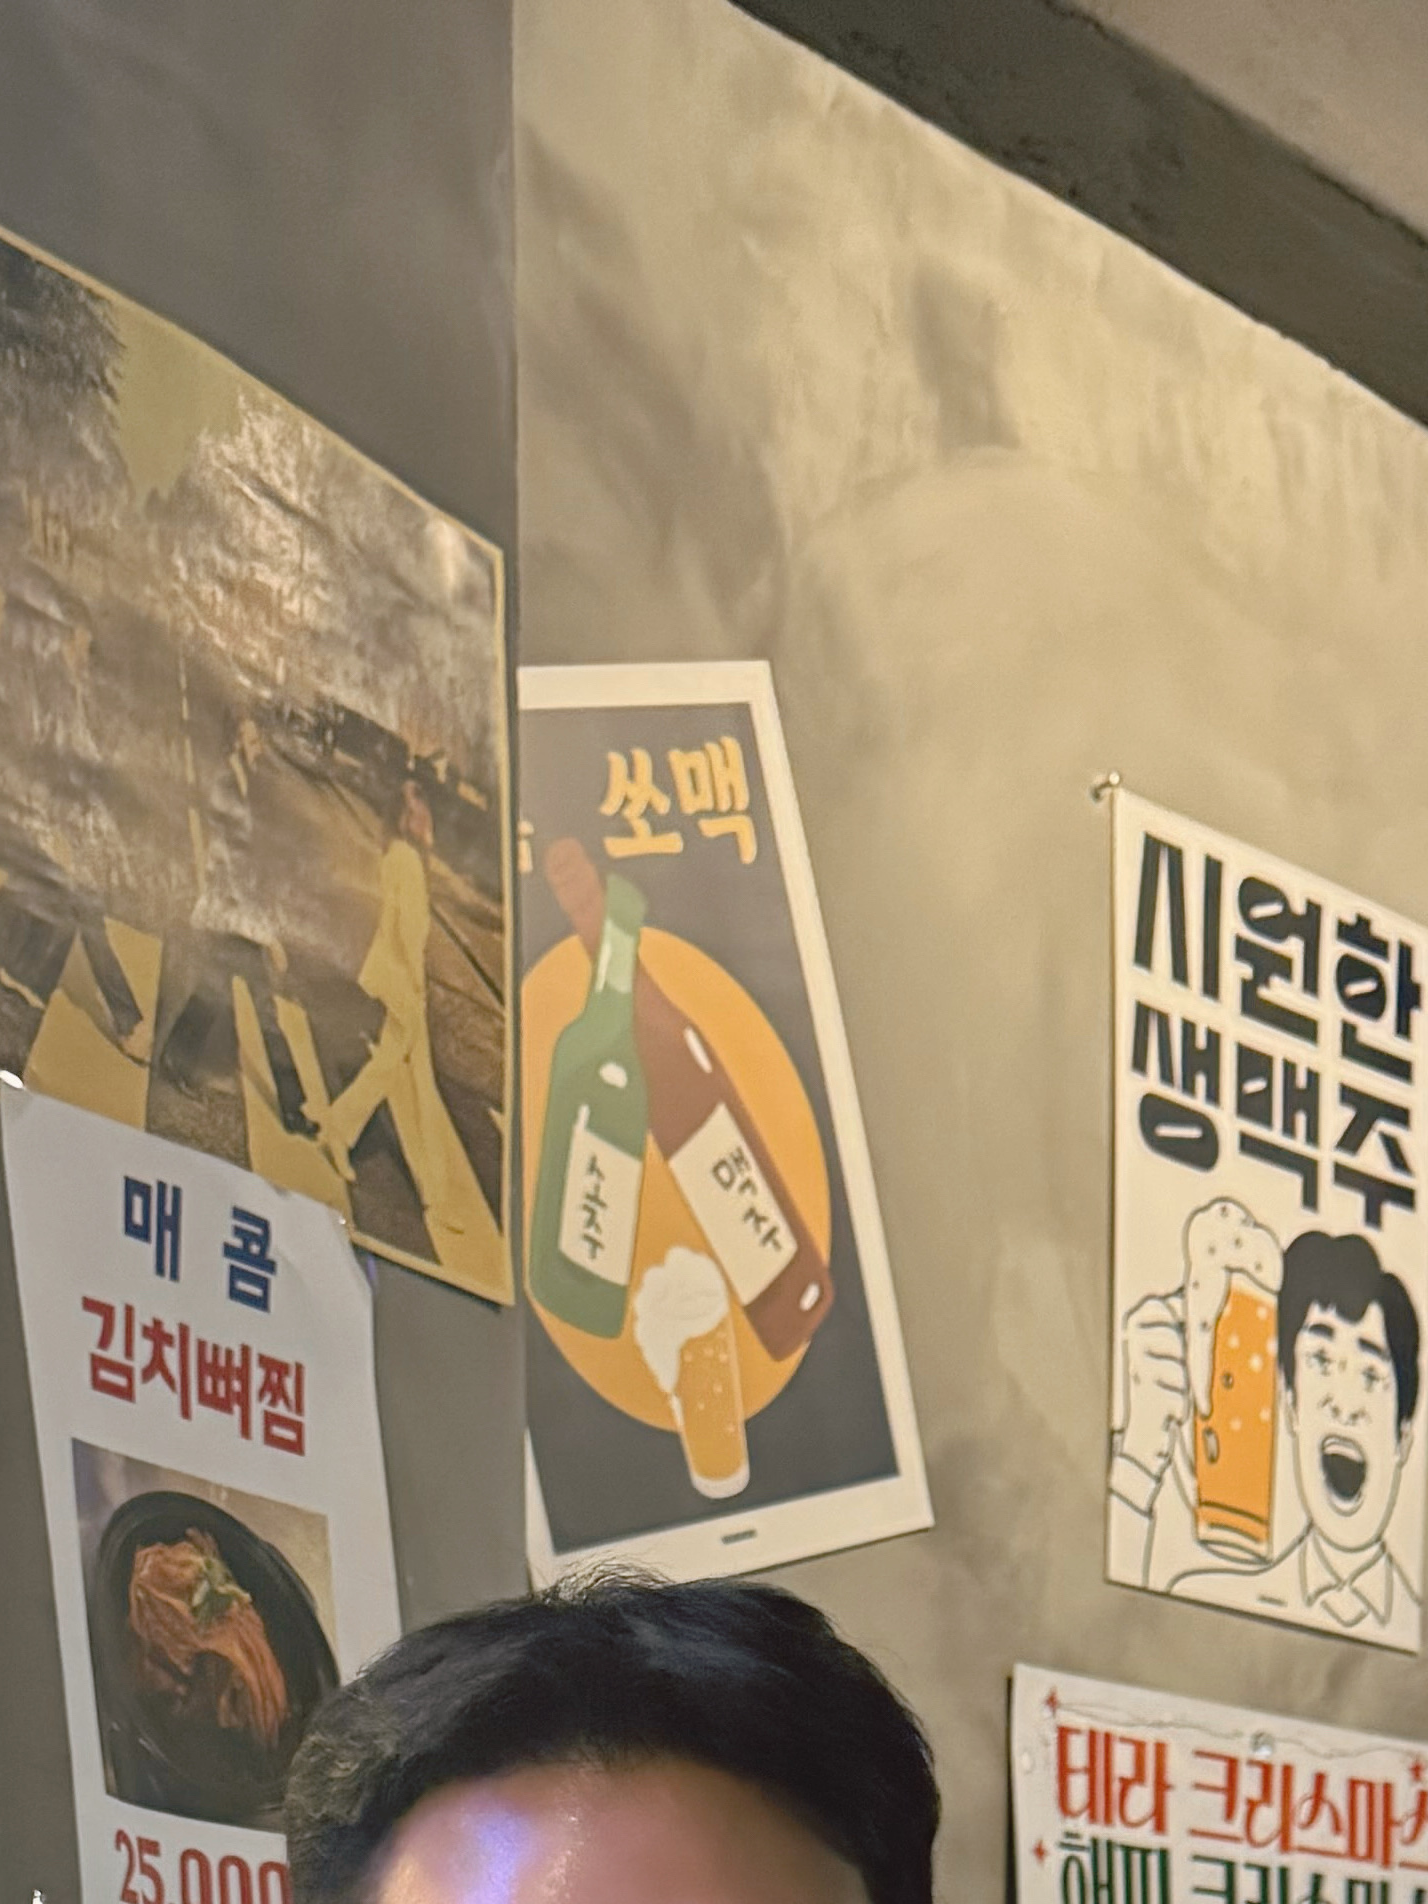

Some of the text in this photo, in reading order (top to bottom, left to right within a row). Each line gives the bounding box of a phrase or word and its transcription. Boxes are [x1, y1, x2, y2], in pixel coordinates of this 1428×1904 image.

[599, 736, 757, 865] 쏘맥
[1133, 831, 1421, 1086] 시원한
[1130, 1000, 1416, 1231] 생맥주
[580, 1154, 608, 1260] 소주
[81, 1296, 305, 1457] 김치뼈찜
[1056, 1725, 1174, 1836] 테라
